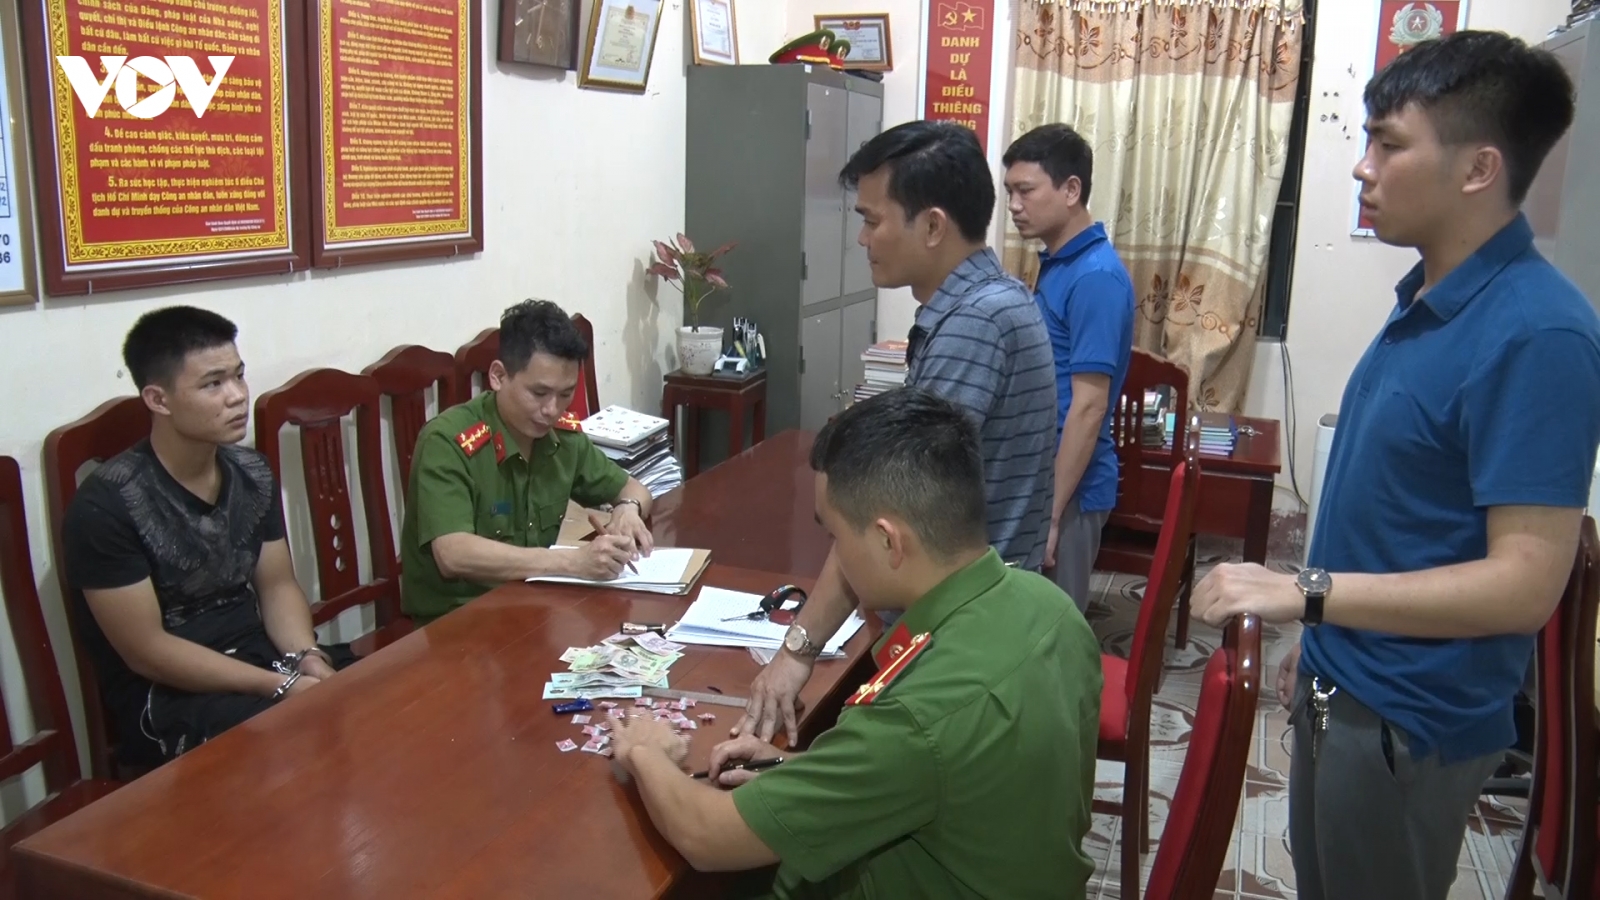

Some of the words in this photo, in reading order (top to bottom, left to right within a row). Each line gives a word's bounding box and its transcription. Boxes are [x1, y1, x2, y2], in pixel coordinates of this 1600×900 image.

[942, 36, 979, 47] DANH
[950, 52, 970, 66] DỰ
[950, 68, 967, 80] LÀ
[942, 84, 974, 97] ĐIỀU
[932, 101, 982, 114] THIÊNG
